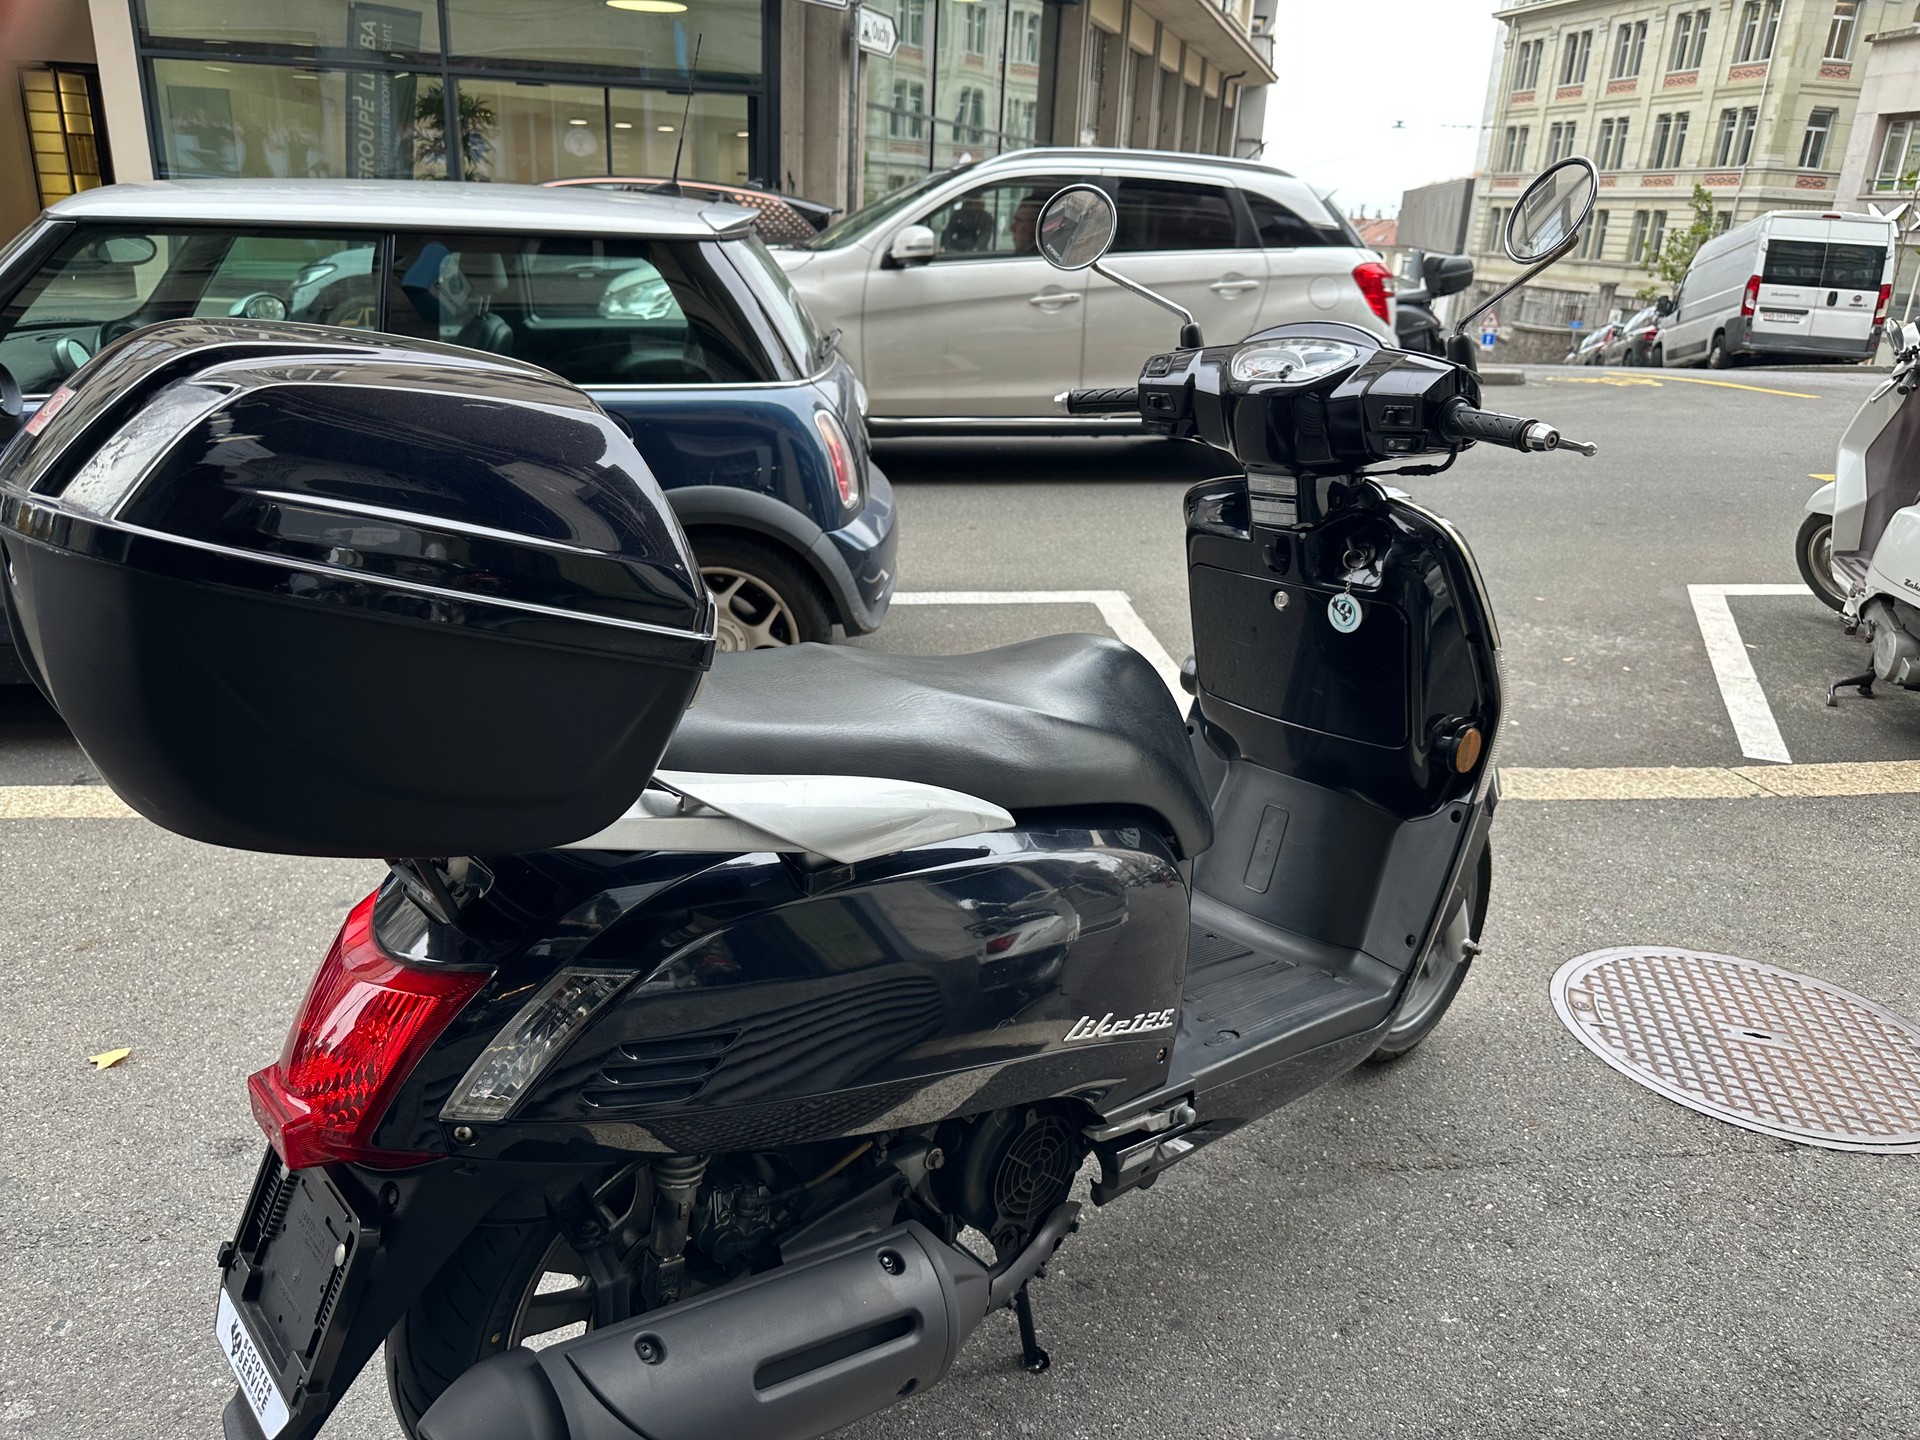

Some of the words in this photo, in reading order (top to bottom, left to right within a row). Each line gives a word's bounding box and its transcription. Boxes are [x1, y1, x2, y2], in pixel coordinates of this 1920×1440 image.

[872, 20, 891, 49] Ouchy
[238, 1349, 269, 1411] SERVICE
[243, 1338, 272, 1397] SCOOTER
